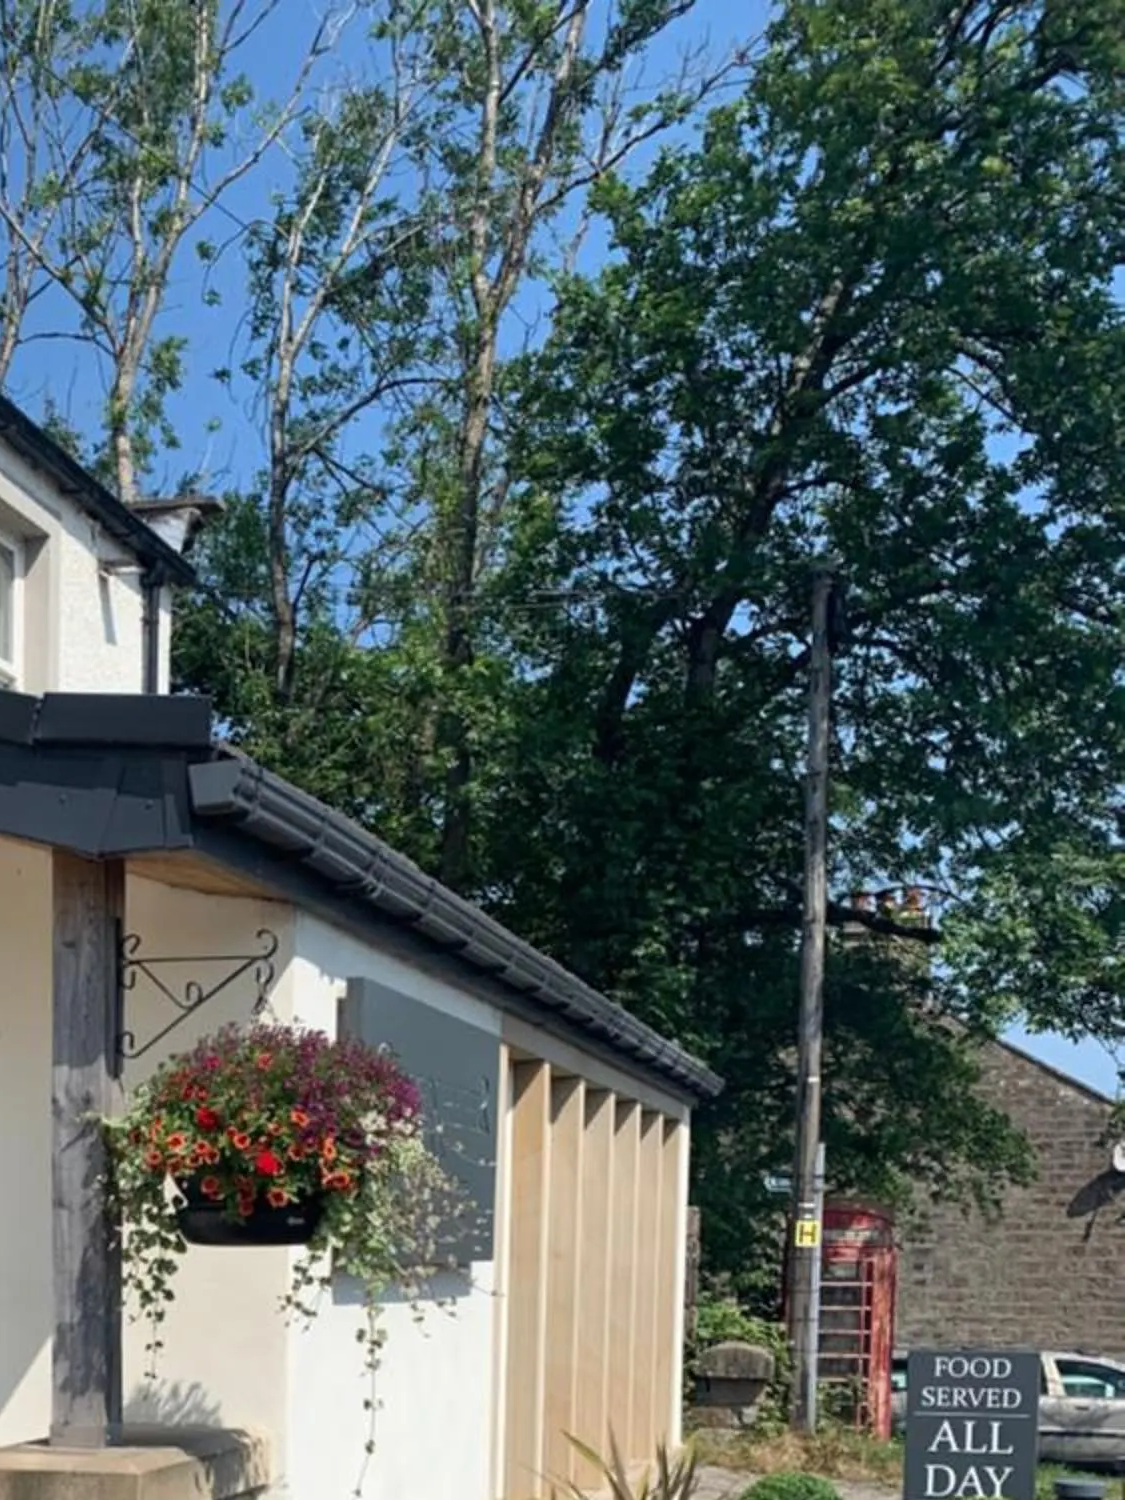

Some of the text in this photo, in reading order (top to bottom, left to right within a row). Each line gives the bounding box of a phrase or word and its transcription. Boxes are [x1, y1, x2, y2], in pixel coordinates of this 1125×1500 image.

[798, 1223, 817, 1244] H
[933, 1356, 1012, 1379] FOOD
[921, 1386, 1022, 1409] SERVED
[927, 1419, 1014, 1455] ALL
[924, 1463, 1014, 1499] DAY
